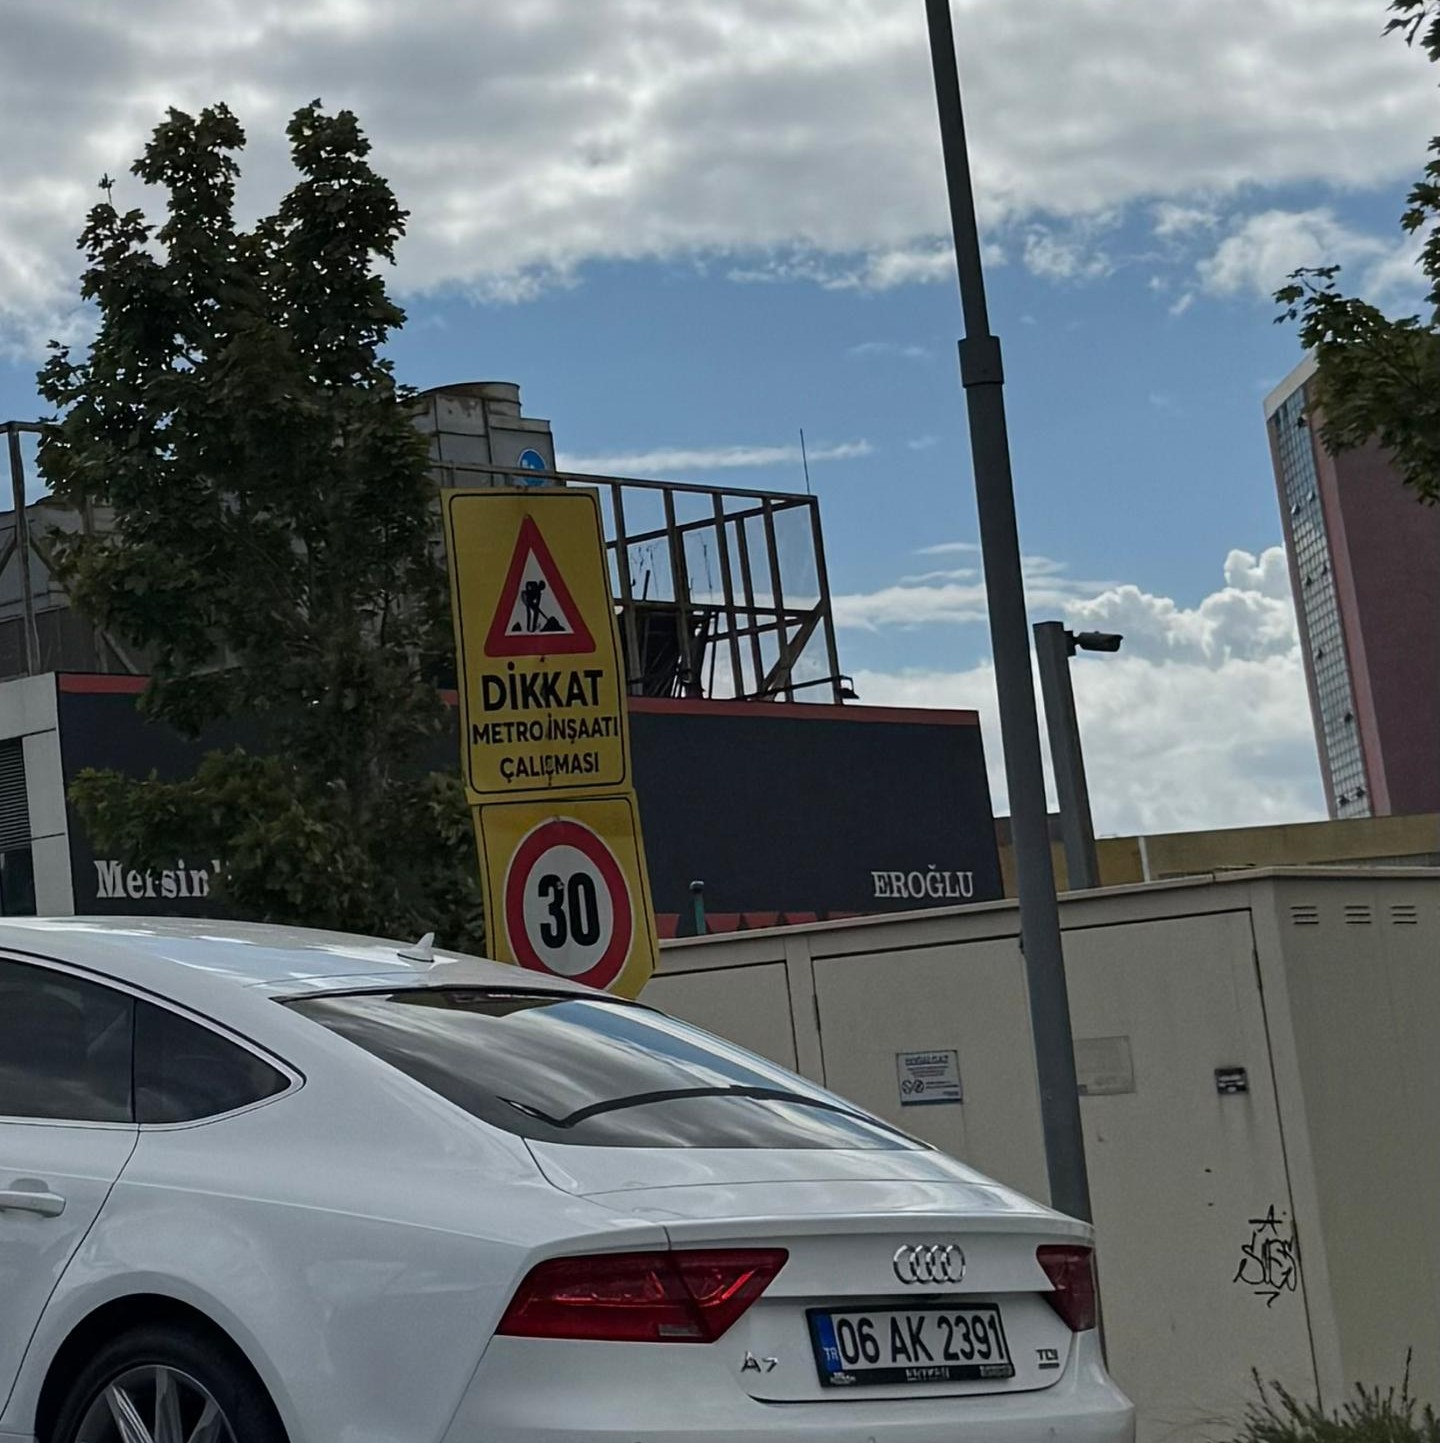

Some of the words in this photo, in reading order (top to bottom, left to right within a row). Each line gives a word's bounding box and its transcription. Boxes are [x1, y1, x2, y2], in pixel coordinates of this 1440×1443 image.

[481, 661, 603, 711] DİKKAT
[472, 720, 543, 744] METRO
[546, 712, 618, 744] İNŞAATI
[871, 864, 973, 898] EROĞLU
[538, 872, 600, 948] 30
[836, 1317, 880, 1365] 06
[890, 1315, 934, 1363] AK
[937, 1314, 1006, 1361] 2391
[740, 1351, 778, 1373] A7
